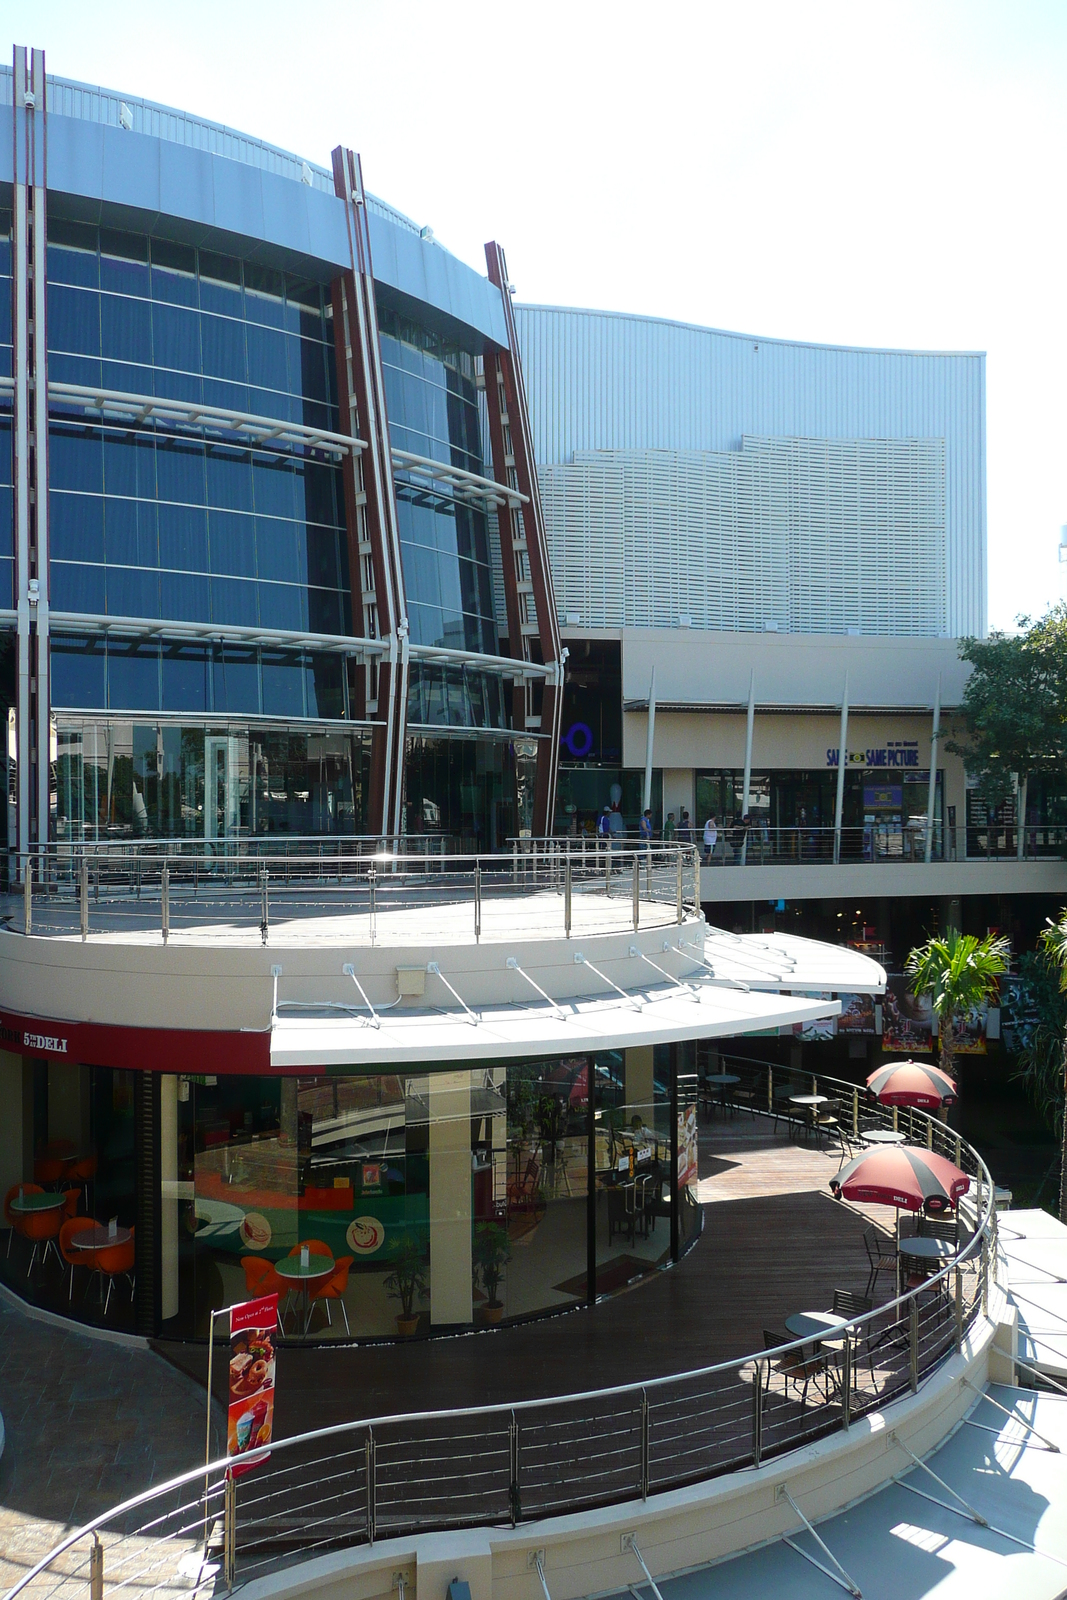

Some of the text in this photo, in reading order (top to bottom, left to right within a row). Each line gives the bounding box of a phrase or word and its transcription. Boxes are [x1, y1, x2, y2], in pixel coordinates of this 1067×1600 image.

[866, 749, 887, 766] SAME
[888, 749, 919, 766] PICTURE
[36, 1035, 68, 1053] DELI
[893, 1195, 908, 1204] DELI
